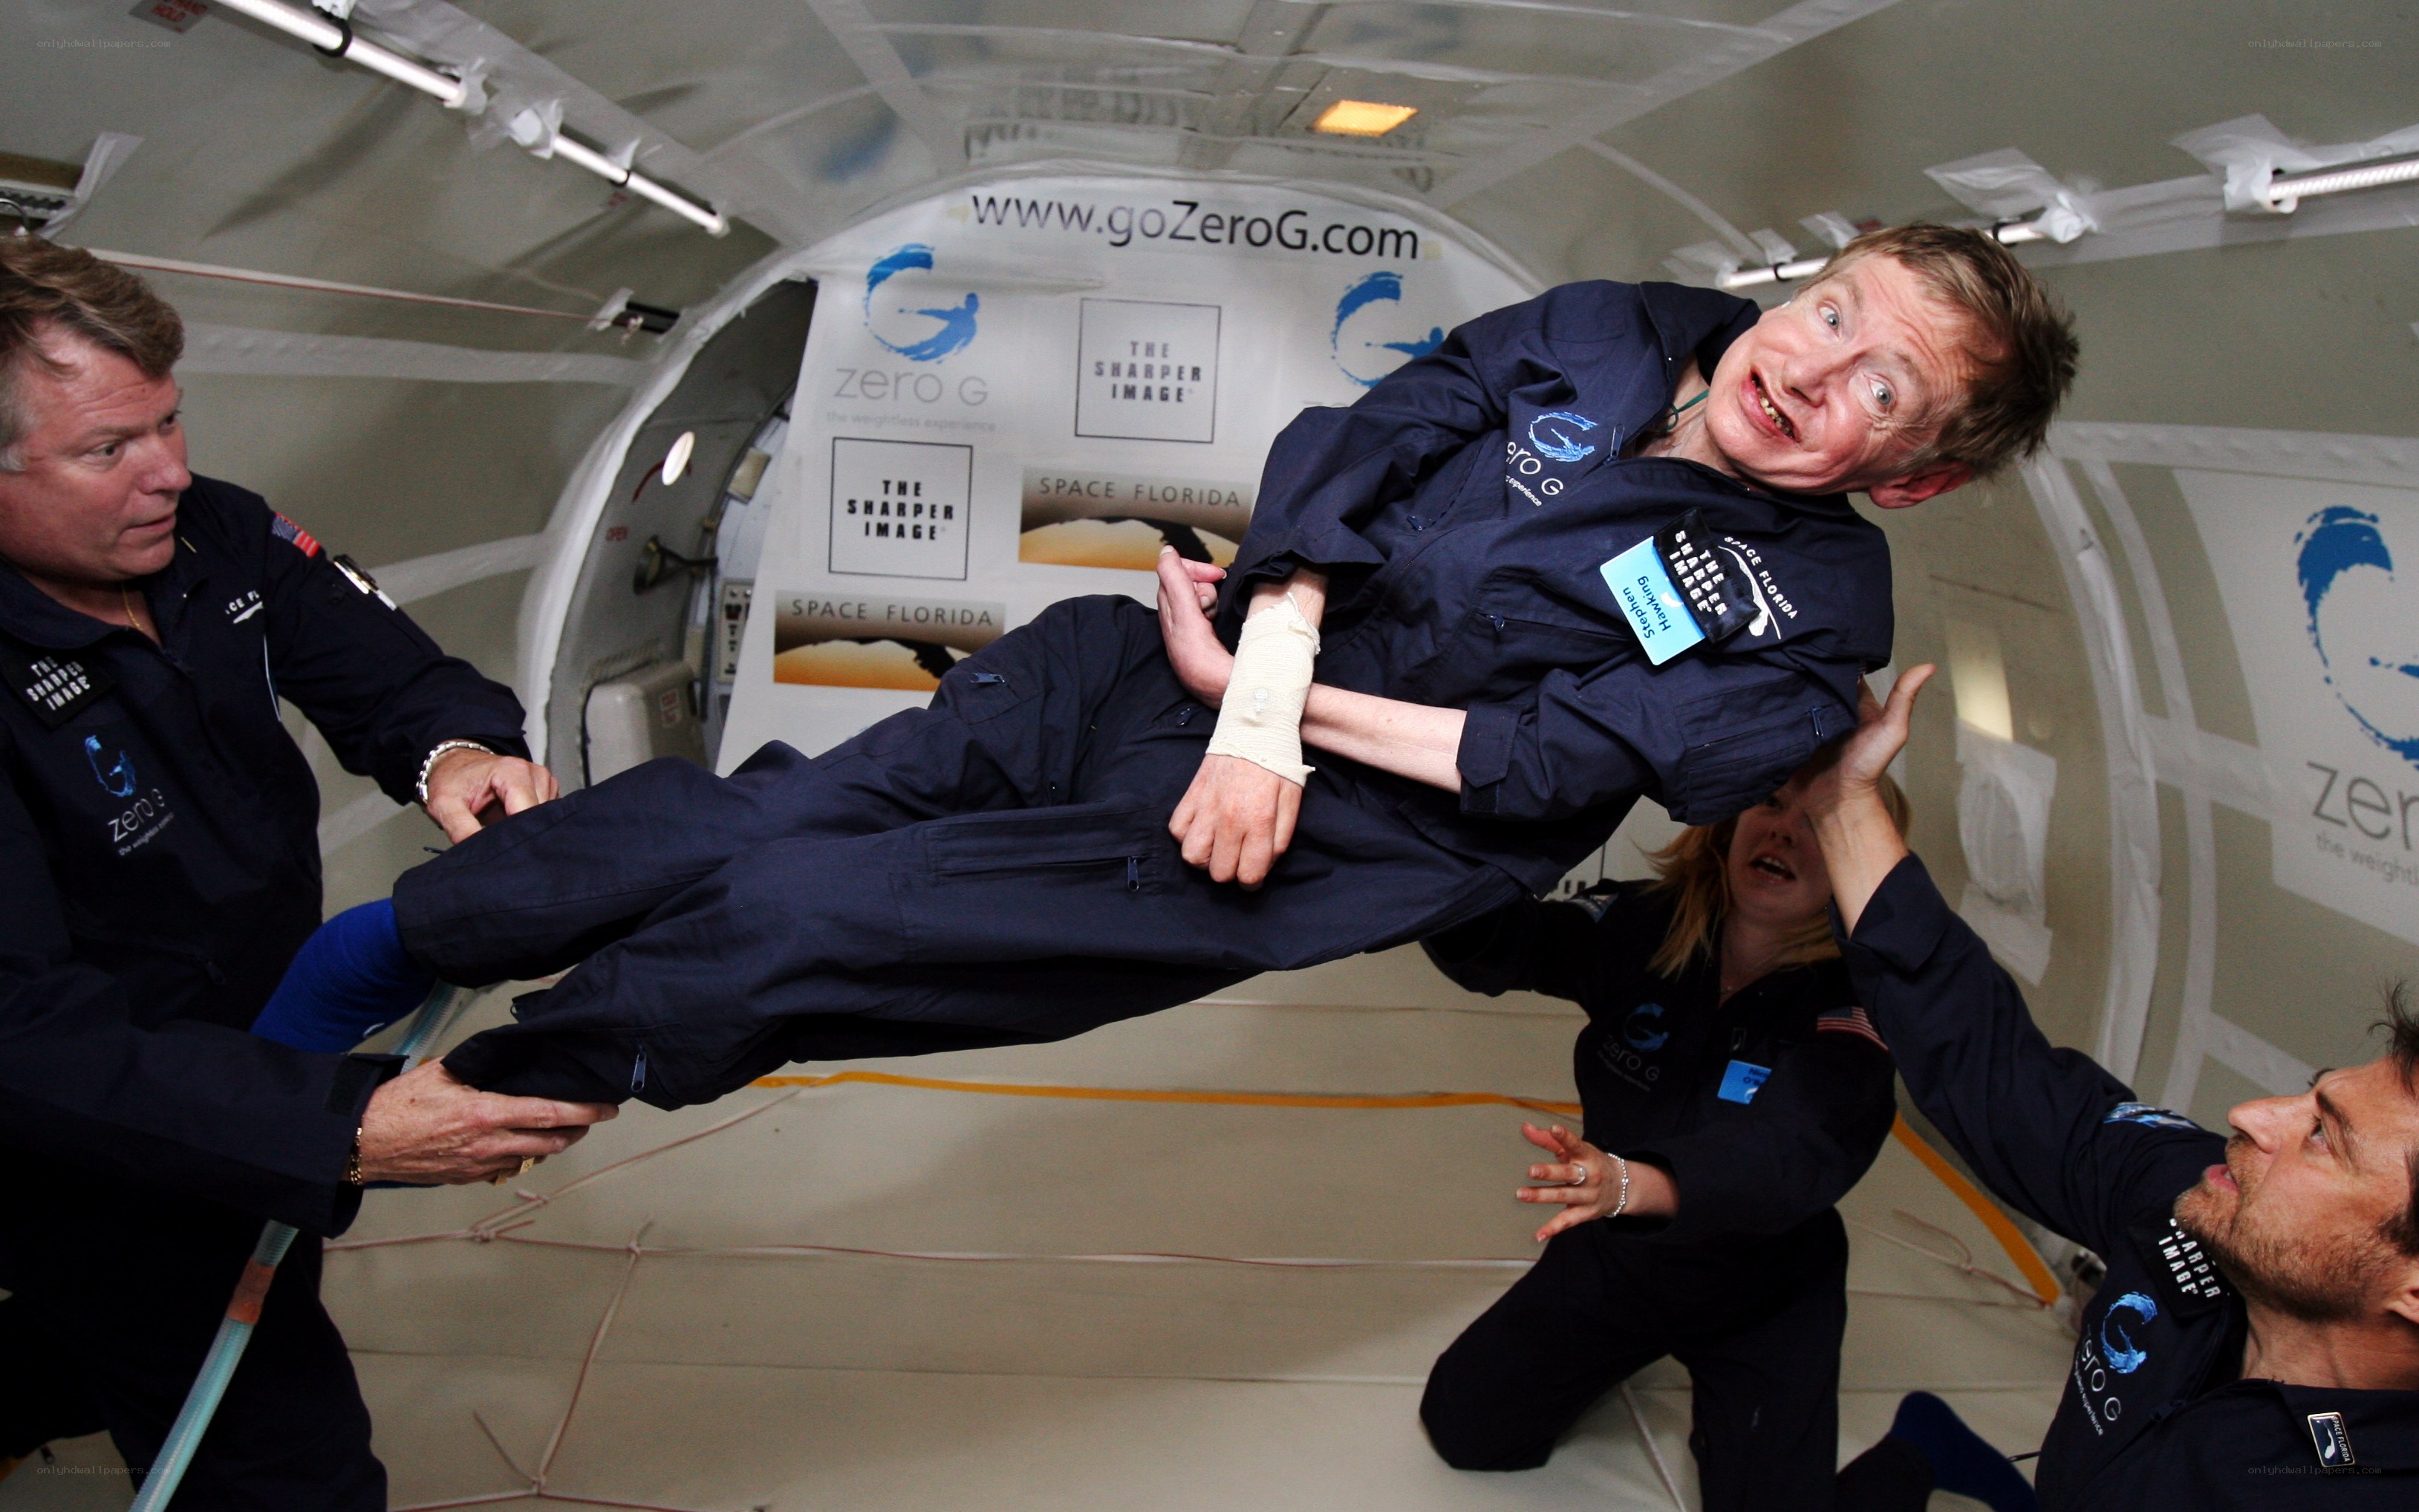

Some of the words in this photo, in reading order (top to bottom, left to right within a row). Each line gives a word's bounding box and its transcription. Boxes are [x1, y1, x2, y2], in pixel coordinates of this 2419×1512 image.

[971, 195, 1419, 260] www.goZeroG.com
[1130, 341, 1169, 358] THE
[833, 368, 943, 403] zero
[958, 376, 988, 406] G
[1095, 361, 1201, 382] SHARPER
[1505, 441, 1541, 475] ero
[1541, 478, 1563, 495] G
[882, 480, 921, 497] THE
[1039, 477, 1115, 498] SPACE
[1134, 483, 1240, 506] FLORIDA
[847, 499, 953, 520] SHARPER
[1675, 530, 1728, 616] SHARPER
[1699, 550, 1725, 584] THE
[792, 599, 867, 619] SPACE
[886, 605, 993, 626] FLORIDA
[1637, 575, 1671, 632] Hawking
[1759, 570, 1798, 619] FLORIDA
[1622, 587, 1655, 639] Stephen
[26, 661, 84, 702] SHARPER
[30, 656, 58, 677] THE
[108, 798, 154, 843] zero
[2306, 760, 2419, 851] zer
[2104, 1396, 2121, 1421] G
[2337, 1436, 2351, 1462] FLORIDA
